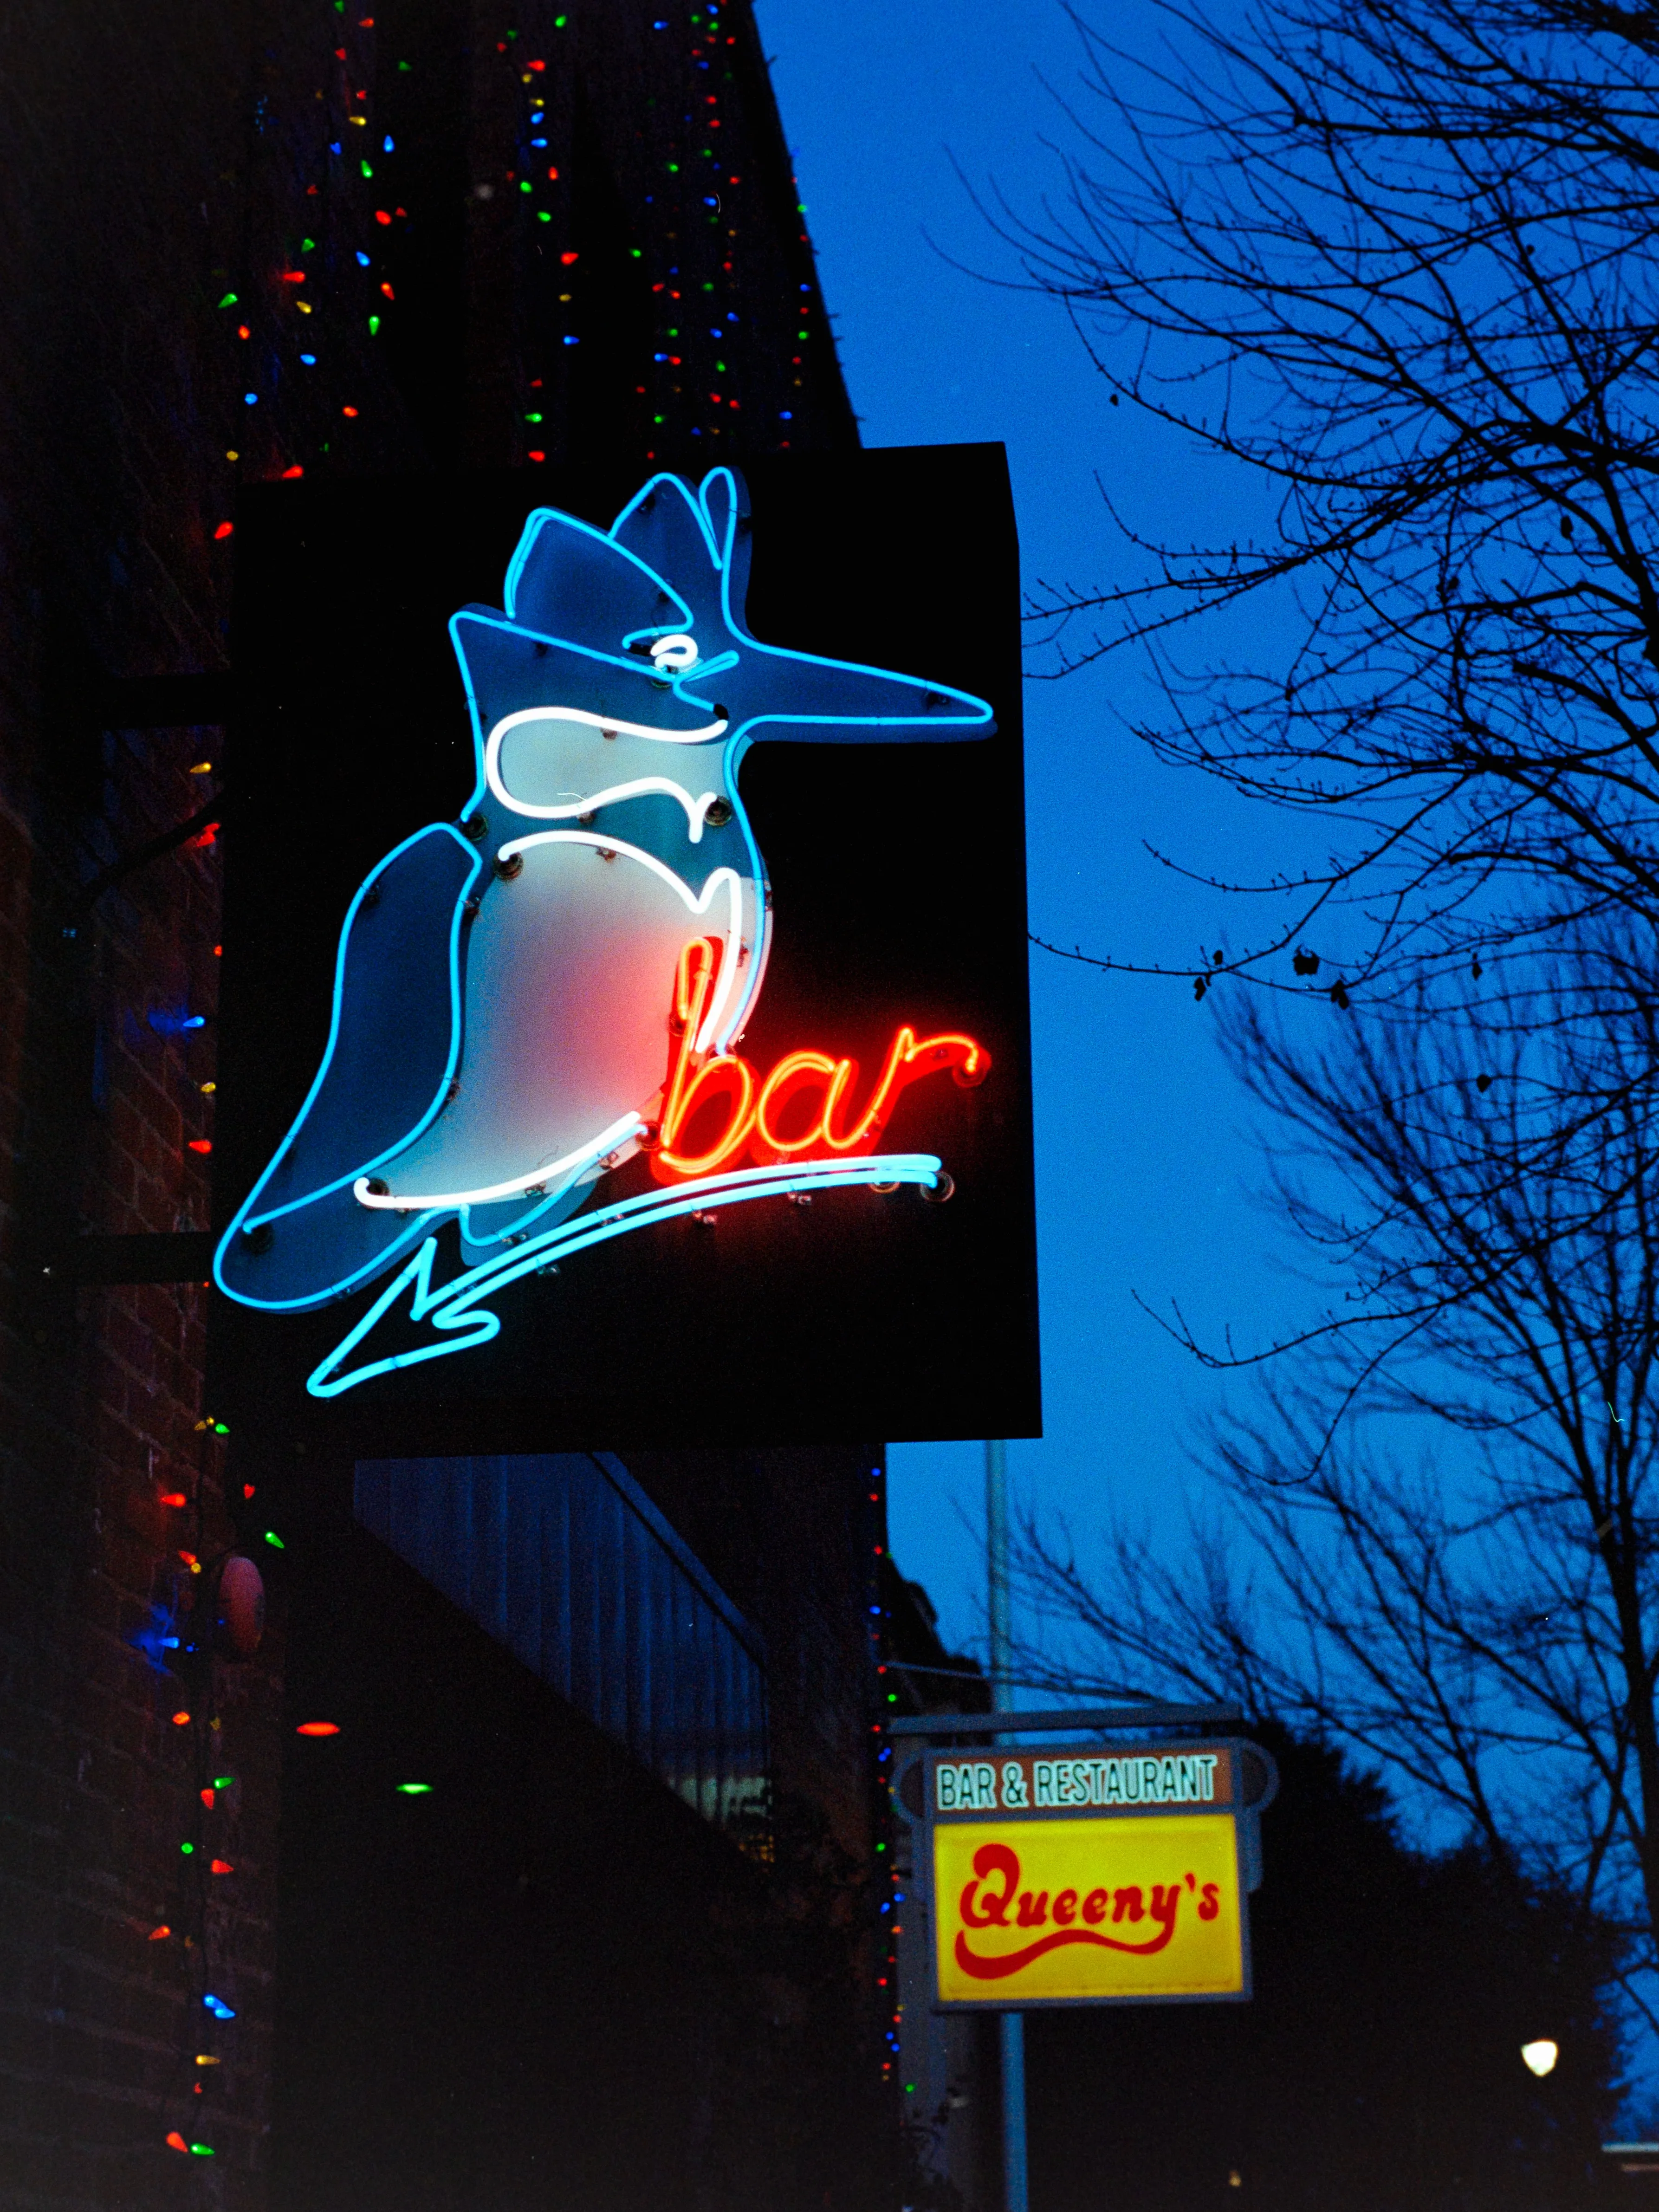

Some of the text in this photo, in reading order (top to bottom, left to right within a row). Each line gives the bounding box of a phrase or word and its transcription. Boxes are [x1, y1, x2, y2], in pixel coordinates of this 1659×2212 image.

[651, 936, 992, 1185] bar
[937, 1755, 1218, 1810] BAR & RESTAURANT
[954, 1843, 1220, 1979] Queeny's
